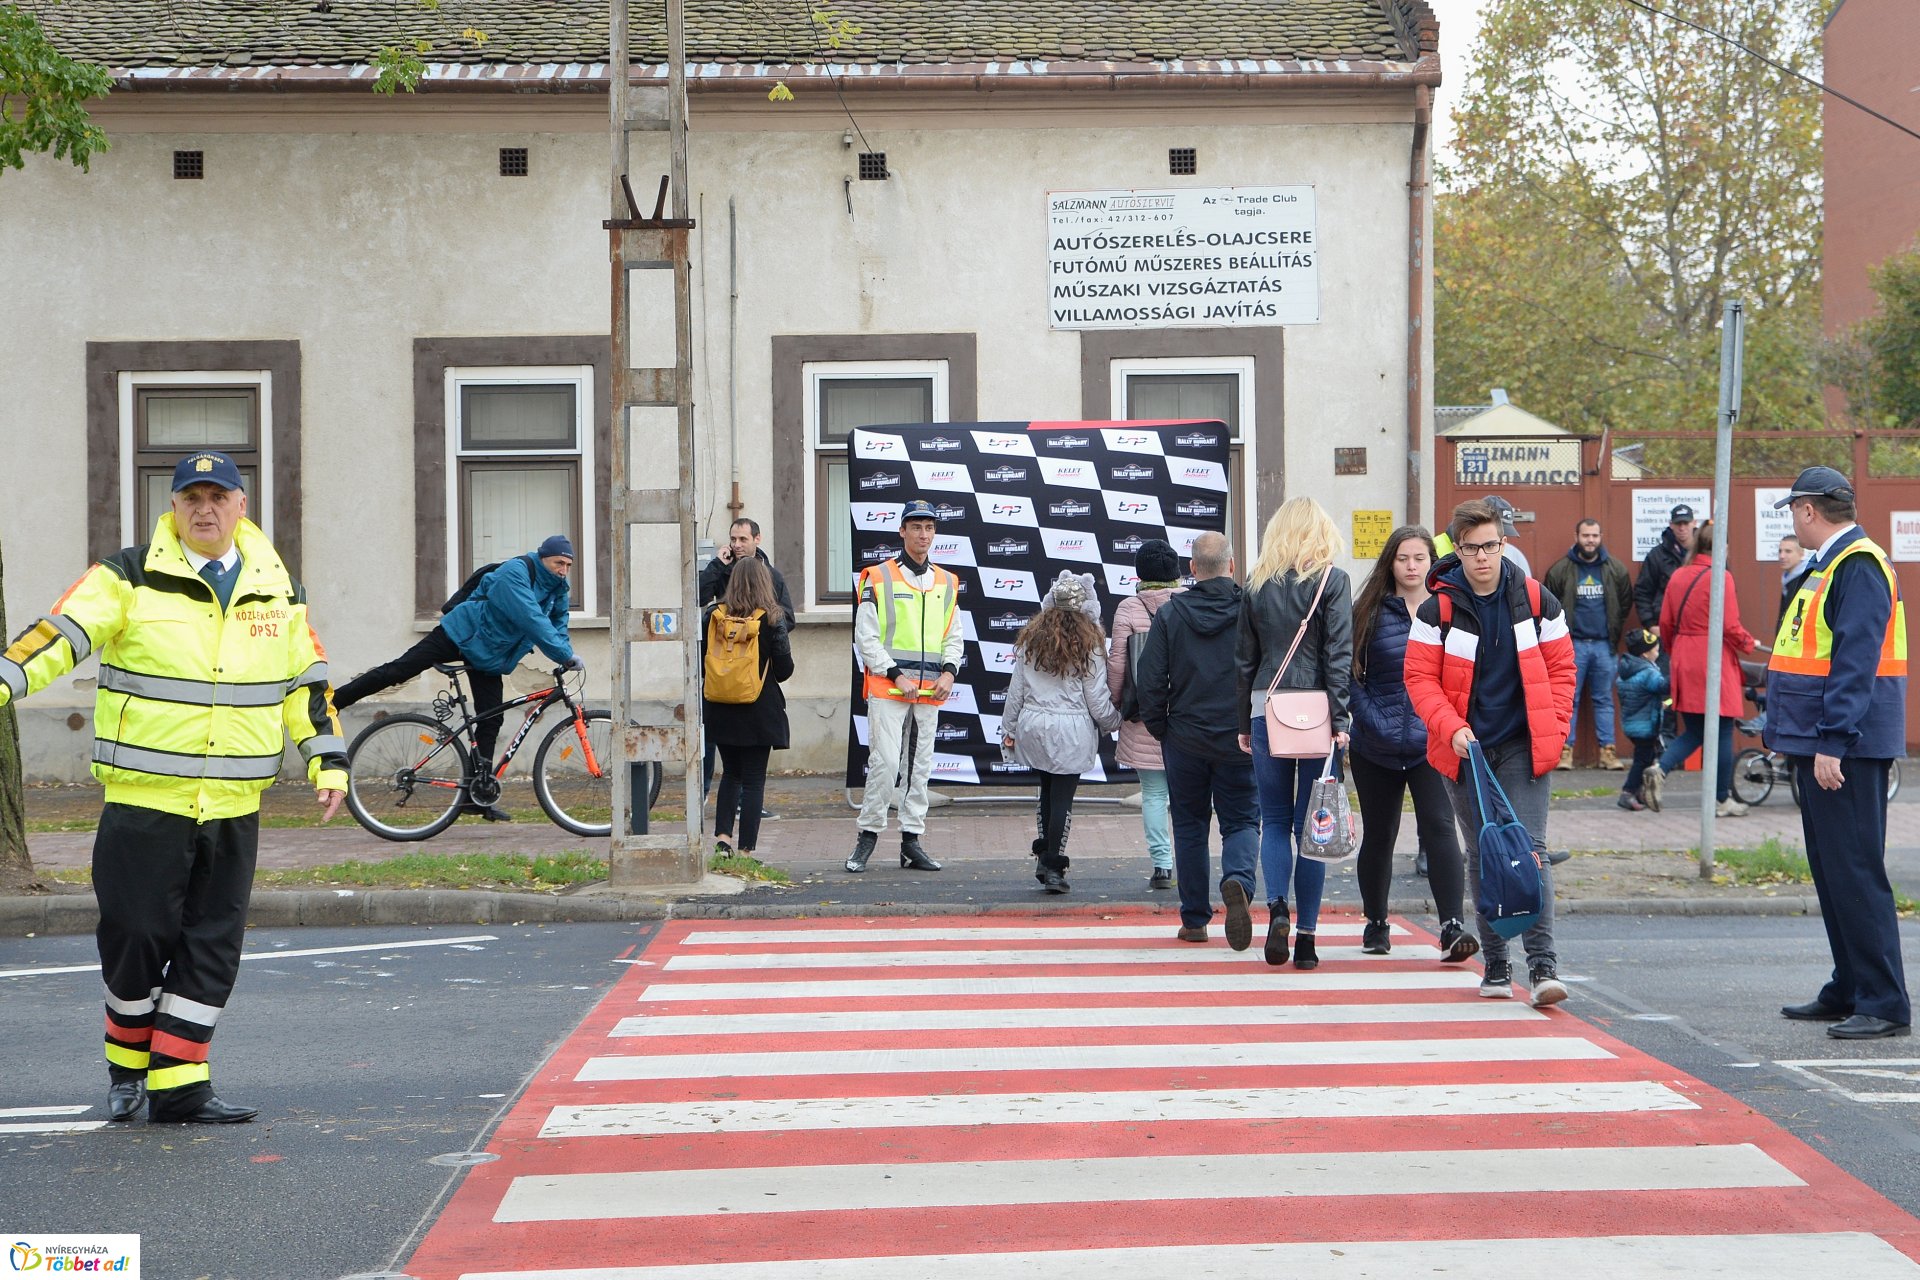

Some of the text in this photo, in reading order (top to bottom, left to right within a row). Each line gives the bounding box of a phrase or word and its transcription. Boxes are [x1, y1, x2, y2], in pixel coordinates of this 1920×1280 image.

[1052, 199, 1107, 211] SALZMANN
[1203, 194, 1297, 205] Az Trade Club
[1108, 213, 1174, 222] 42/312-607
[1234, 208, 1265, 217] tagja.
[1053, 230, 1312, 251] AUTÓSZERELÉS-OLAJCSERE
[1053, 251, 1313, 274] FUTÓMŰ MŰSZERES BEÁLLÍTÁS
[1053, 276, 1283, 298] MŰSZAKI VIZSGÁZTATÁS
[1054, 300, 1277, 322] VILLAMOSSÁGI JAVÍTÁS
[1467, 461, 1484, 472] 21
[1113, 469, 1128, 477] RALLY
[861, 480, 876, 488] RALLY
[250, 623, 279, 638] OPSZ
